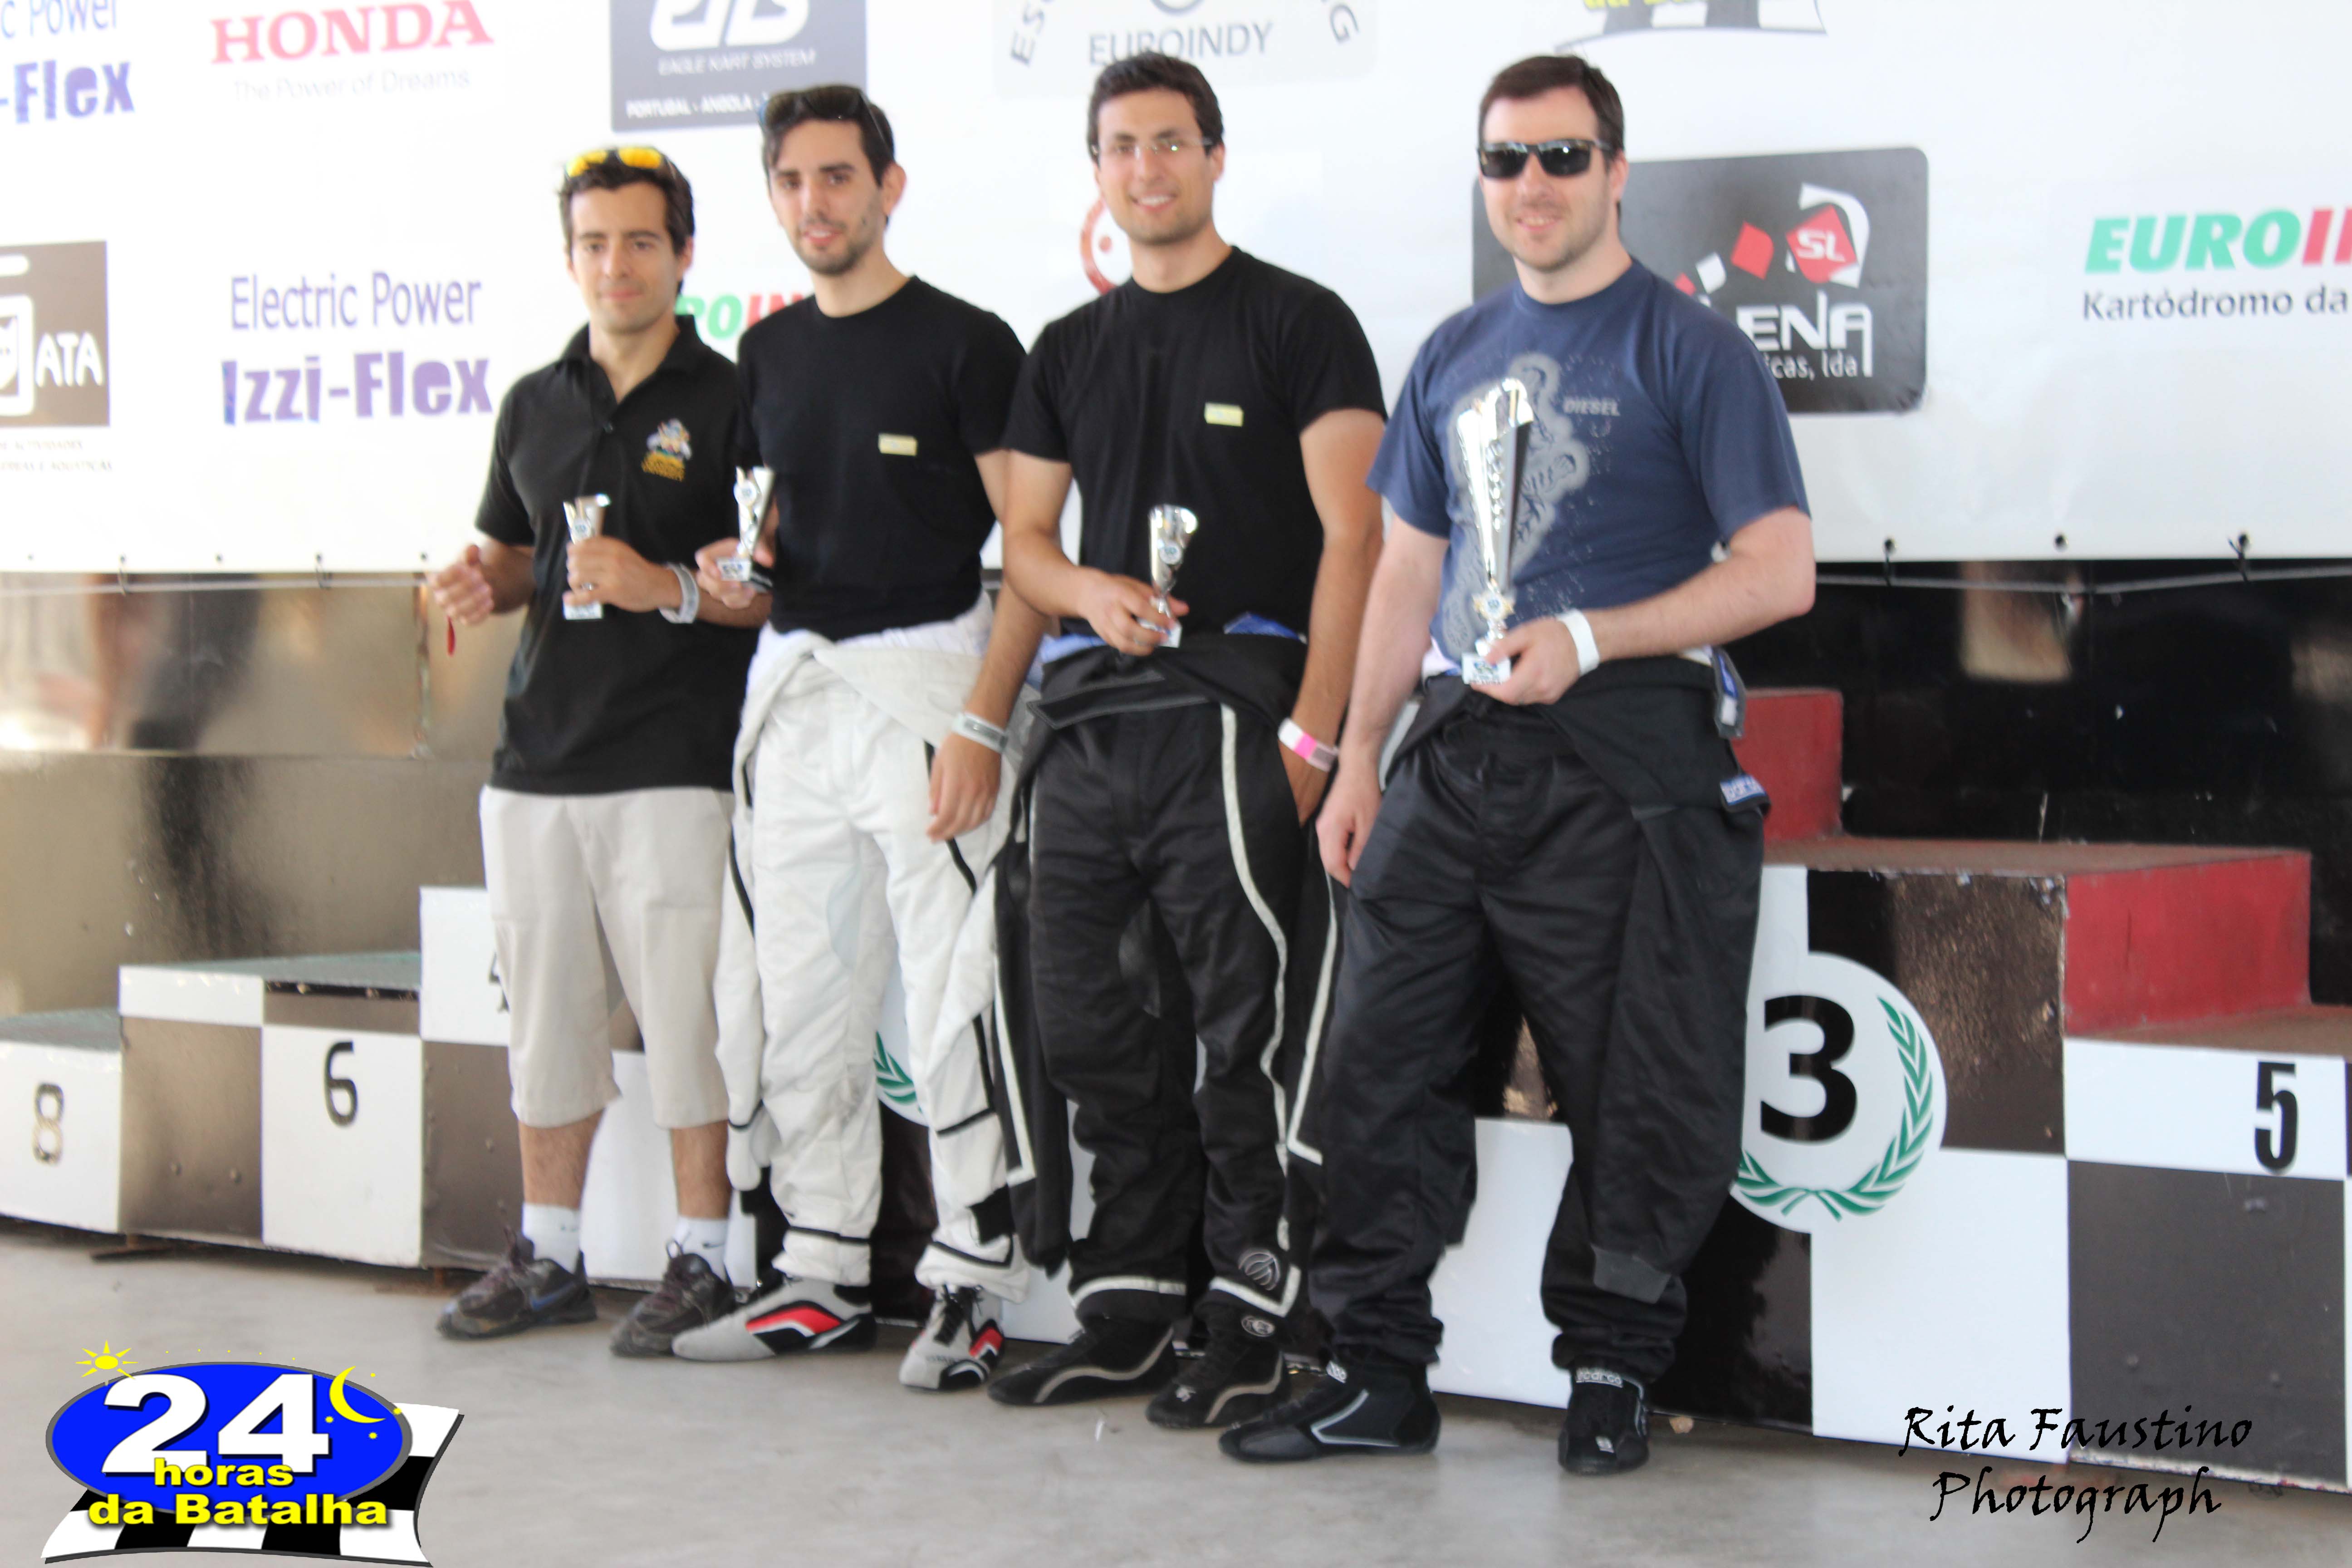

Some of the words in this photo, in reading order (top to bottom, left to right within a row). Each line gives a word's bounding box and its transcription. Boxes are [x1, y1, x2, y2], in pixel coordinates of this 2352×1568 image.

[209, 0, 495, 65] HONDA
[1088, 19, 1274, 68] EUROINDY
[276, 75, 347, 98] Power
[353, 70, 374, 93] of
[382, 67, 471, 92] Dreams
[658, 55, 706, 76] EAGLE
[709, 52, 750, 72] KART
[753, 48, 816, 69] SYSTEM
[626, 97, 691, 118] PORTUGAL
[1796, 229, 1846, 262] SL
[230, 272, 358, 330] Electric
[372, 269, 483, 328] Power
[2306, 281, 2349, 314] da
[35, 332, 104, 387] ATA
[220, 349, 495, 426] Izzi-Flex
[1563, 397, 1621, 417] DIESEL
[325, 1040, 358, 1128] 6
[1760, 994, 1857, 1146] 3
[33, 1083, 64, 1165] 8
[2254, 1061, 2298, 1174] 5
